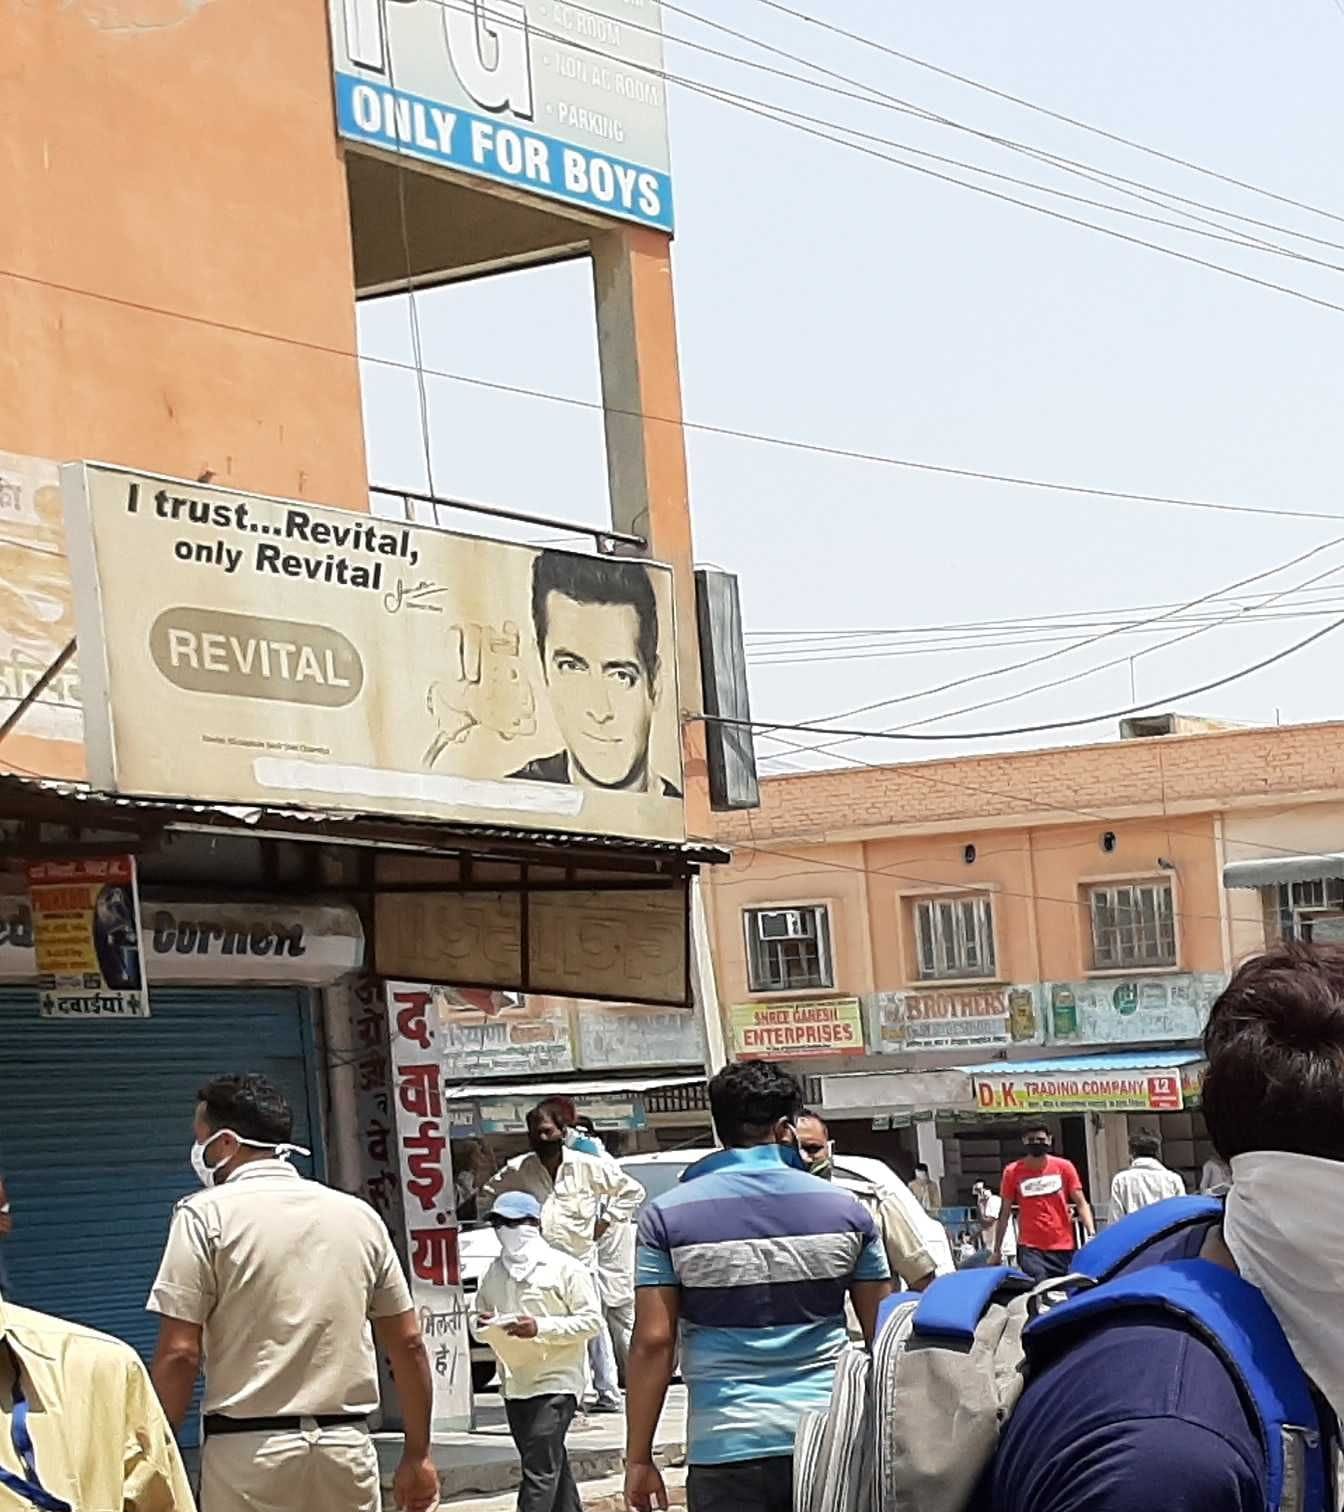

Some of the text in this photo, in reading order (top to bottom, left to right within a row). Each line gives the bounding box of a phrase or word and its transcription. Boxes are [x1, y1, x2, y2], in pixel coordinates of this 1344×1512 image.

[559, 101, 624, 142] PARKING
[352, 84, 662, 218] ONLY FOR BOYS
[127, 483, 140, 513] I
[175, 540, 382, 590] only Revital
[167, 628, 351, 688] REVITAL
[754, 1010, 789, 1025] SHREE
[905, 990, 1008, 1021] BROTHERS
[743, 1022, 854, 1047] ENTERPRISES
[978, 1082, 1024, 1108] D.K.
[1082, 1078, 1145, 1096] COMPANY
